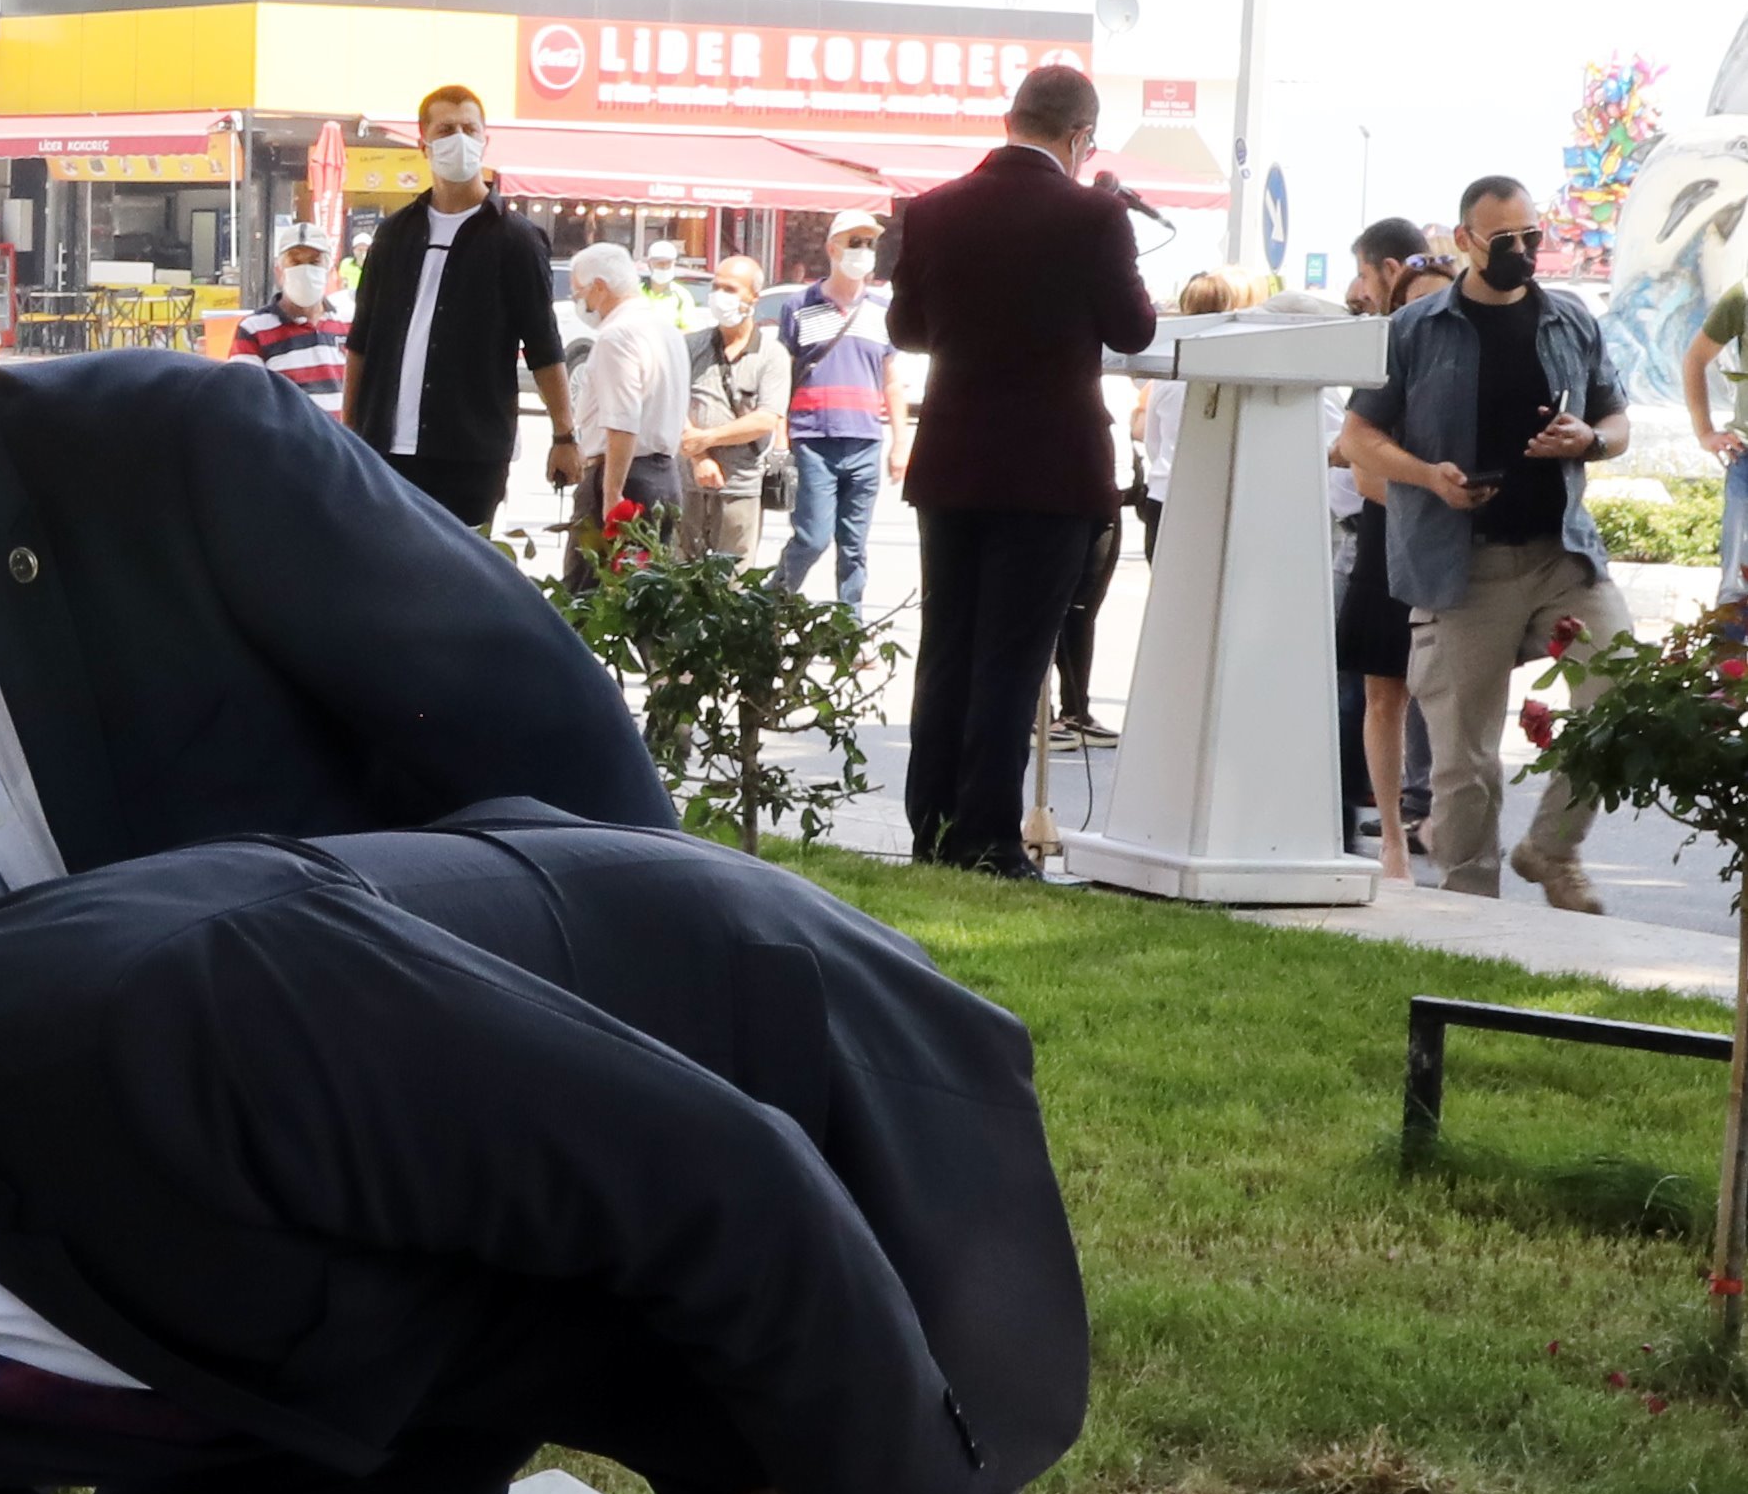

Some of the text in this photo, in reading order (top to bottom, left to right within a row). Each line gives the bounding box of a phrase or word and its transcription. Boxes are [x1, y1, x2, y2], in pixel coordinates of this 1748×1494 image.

[598, 26, 1029, 95] LİDER KOKOREÇ
[38, 140, 110, 152] LİDER KOKOREÇ
